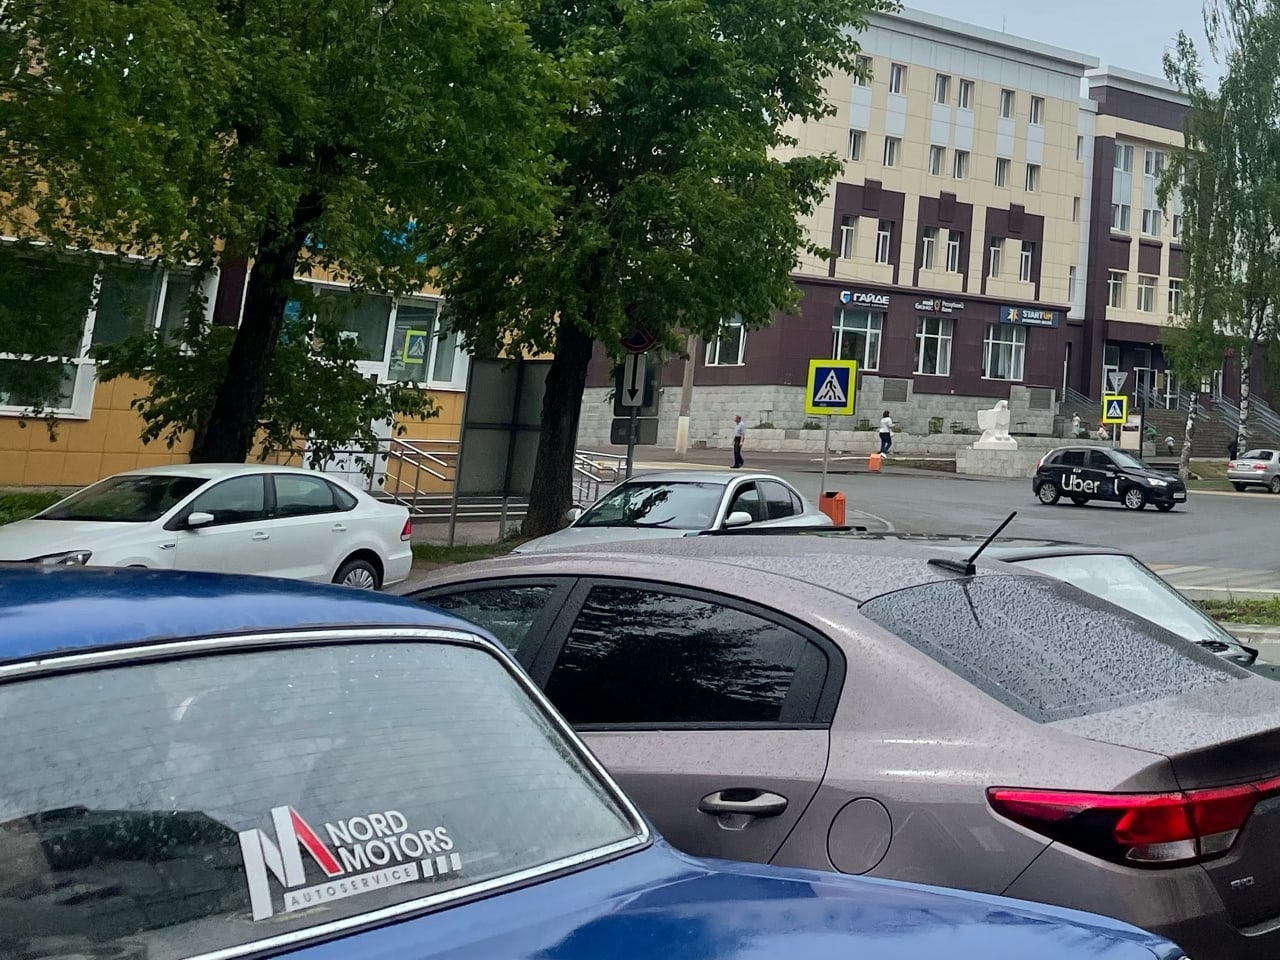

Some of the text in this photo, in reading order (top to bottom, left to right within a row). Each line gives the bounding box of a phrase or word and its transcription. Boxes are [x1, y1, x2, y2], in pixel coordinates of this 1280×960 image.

[854, 292, 890, 305] ГАЙДЕ
[1061, 473, 1101, 493] Uber
[324, 810, 408, 847] NORD
[337, 826, 454, 873] MOTORS
[290, 866, 413, 907] AUTOSERVICE
